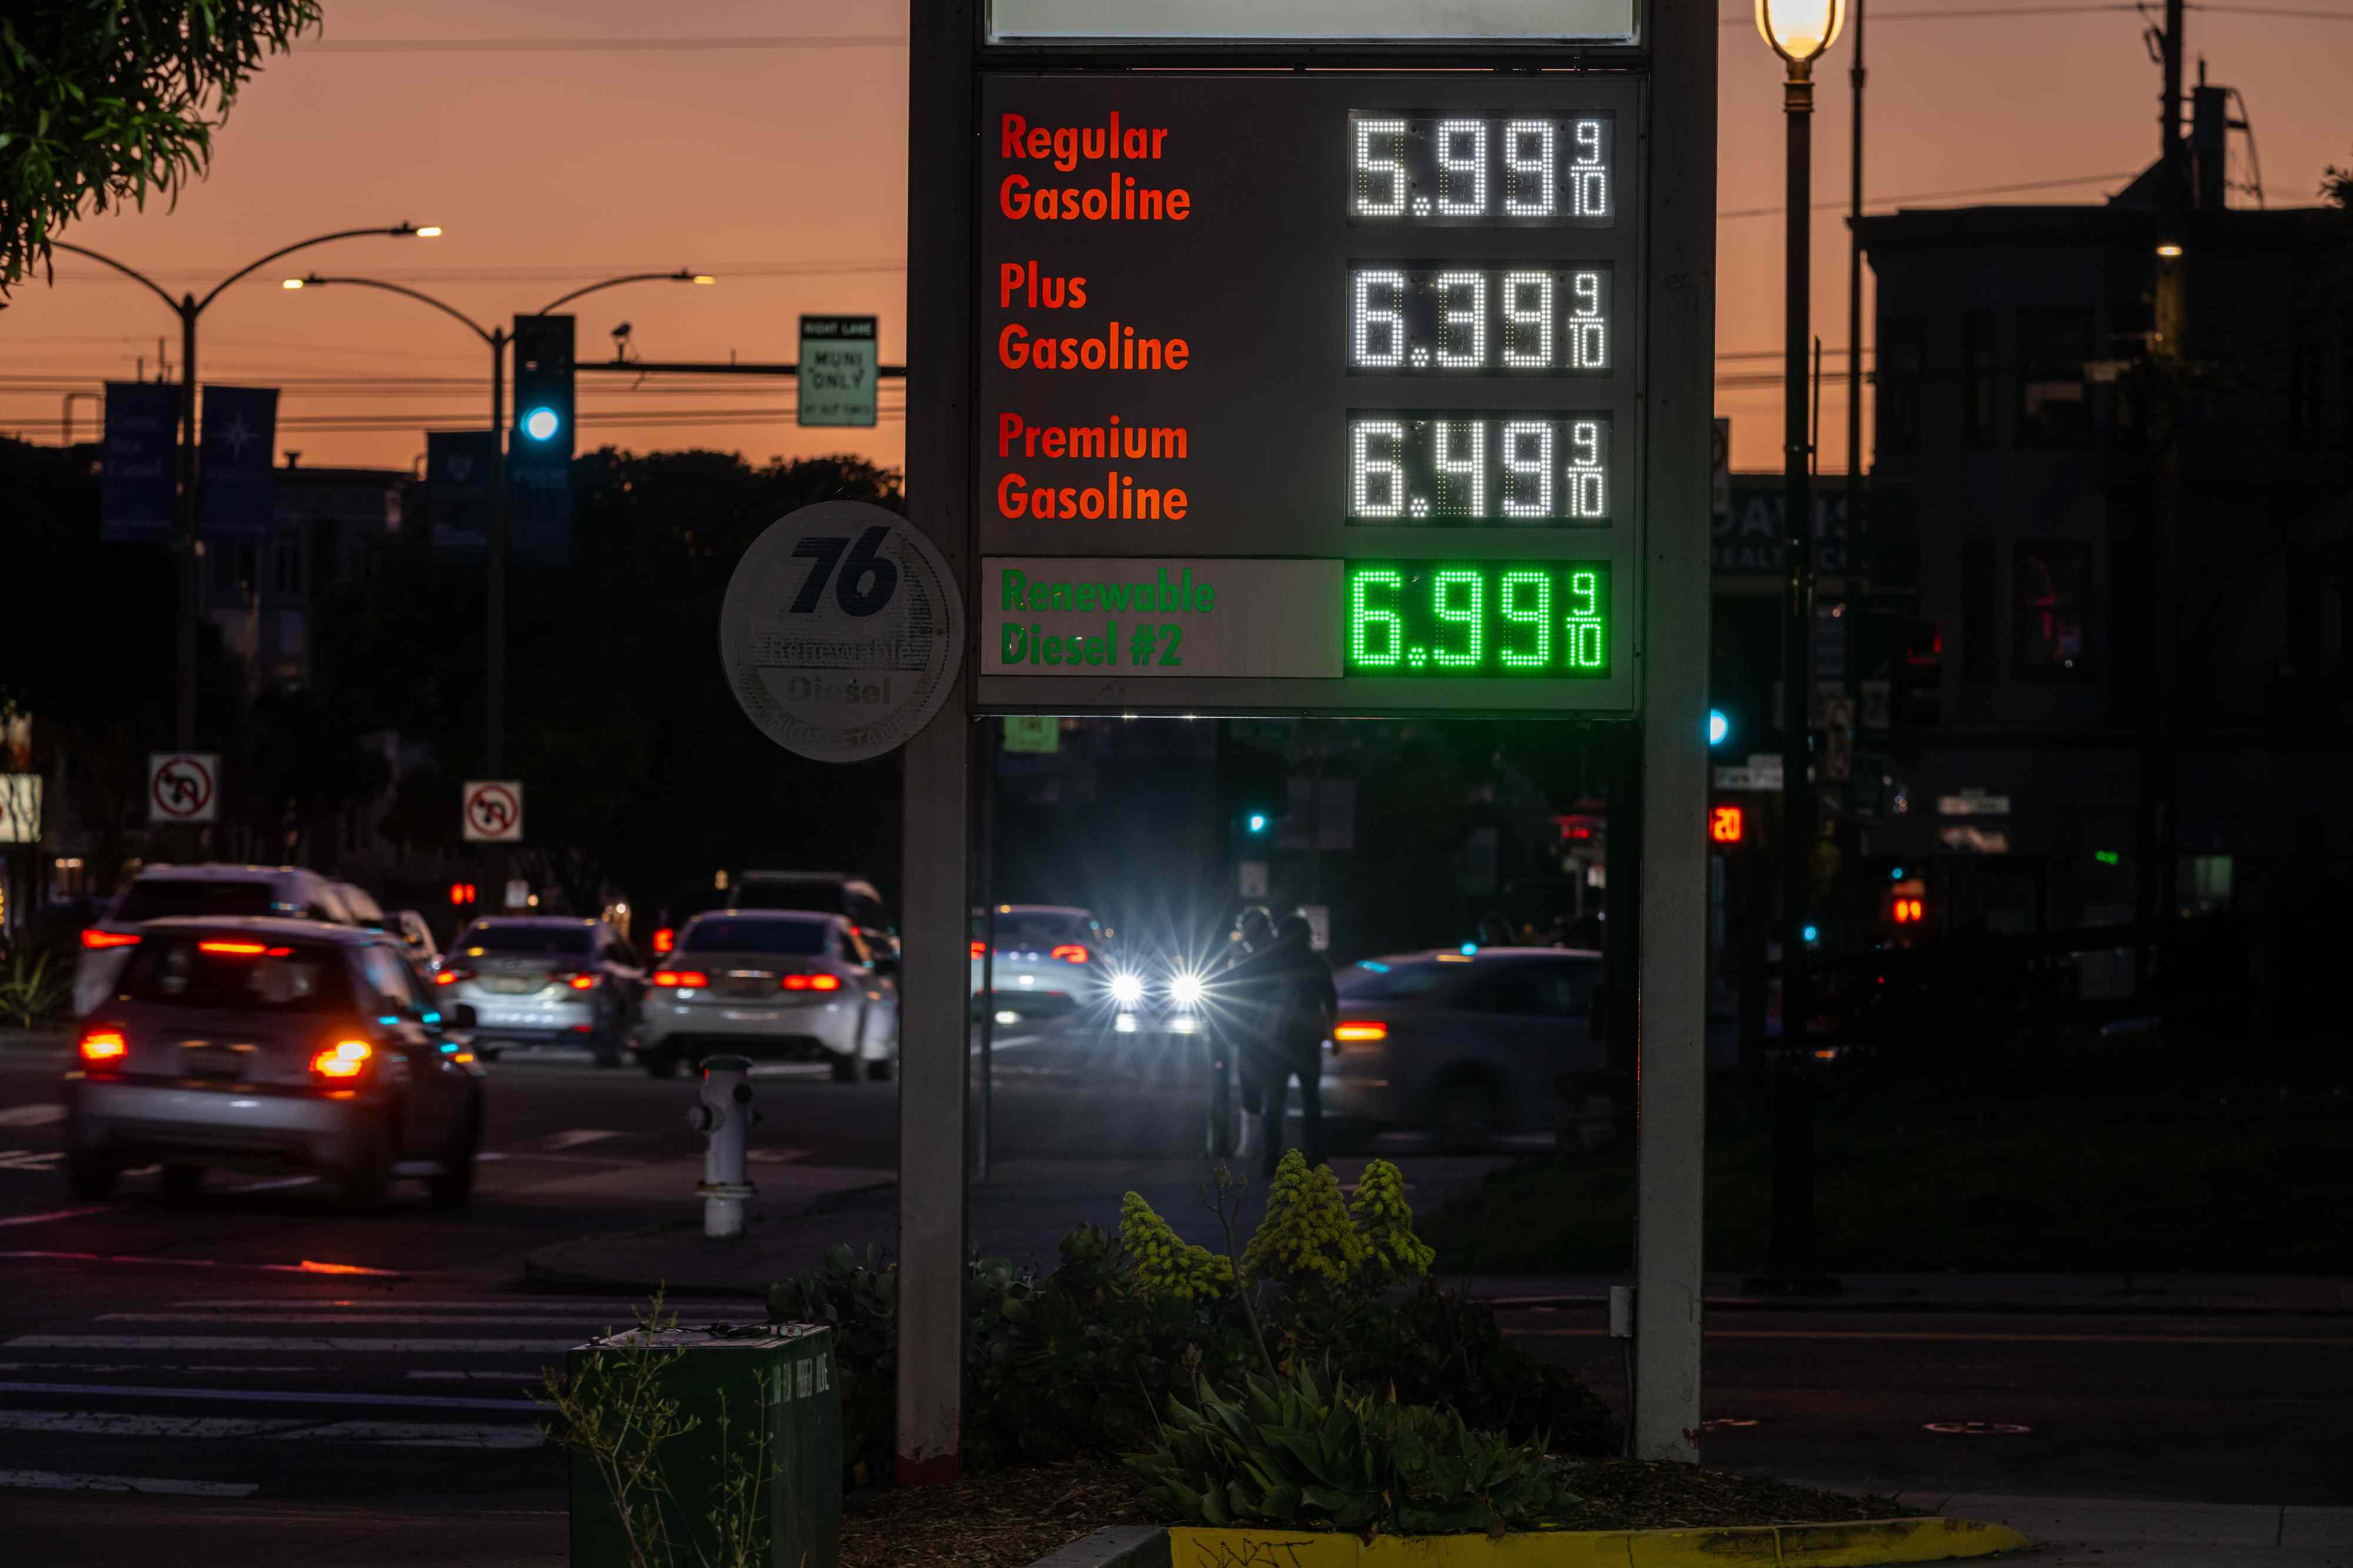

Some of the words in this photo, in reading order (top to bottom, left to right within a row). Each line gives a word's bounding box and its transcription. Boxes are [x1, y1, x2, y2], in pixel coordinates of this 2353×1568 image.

[1001, 110, 1168, 172] Regular
[1358, 121, 1554, 215] 5.99
[999, 172, 1191, 221] Gasoline
[1000, 259, 1087, 309] Plus
[1356, 272, 1552, 367] 6.39
[814, 351, 863, 367] MUNI
[998, 321, 1189, 371] Gasoline
[812, 372, 865, 390] ONLY
[998, 412, 1188, 459] Premium
[1355, 422, 1552, 517] 6.49
[997, 471, 1189, 521] Gasoline
[789, 526, 898, 617] 76
[1002, 567, 1215, 612] Renewable
[1002, 620, 1116, 666] Diesel
[1129, 623, 1182, 666] #2
[1352, 571, 1549, 666] 6.99
[787, 675, 891, 705] Diesel
[1713, 806, 1741, 842] 20
